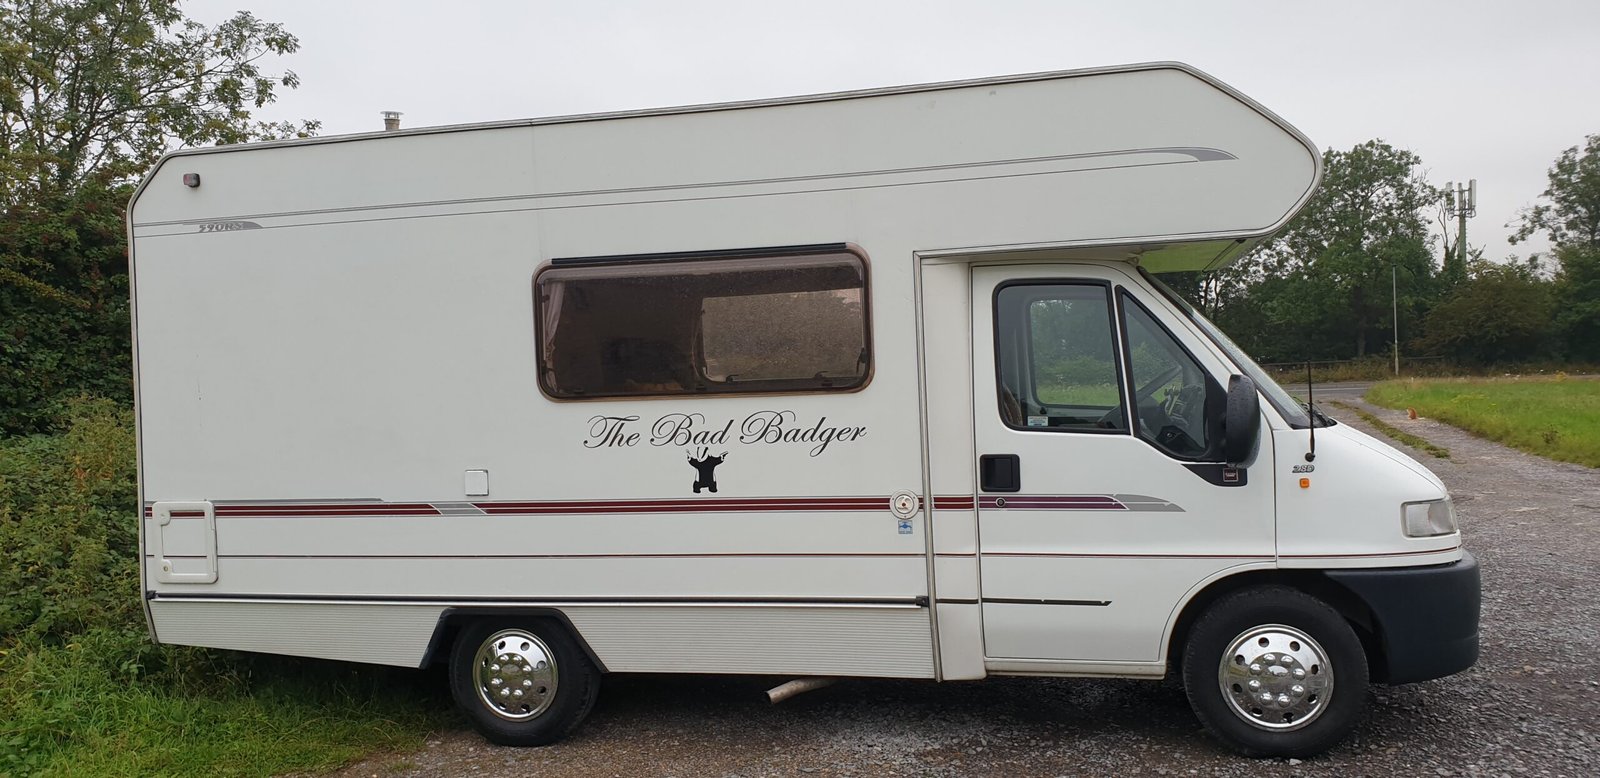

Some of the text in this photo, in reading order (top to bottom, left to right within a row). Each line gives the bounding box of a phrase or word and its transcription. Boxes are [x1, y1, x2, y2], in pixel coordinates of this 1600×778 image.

[583, 410, 868, 457] The Bad Badger
